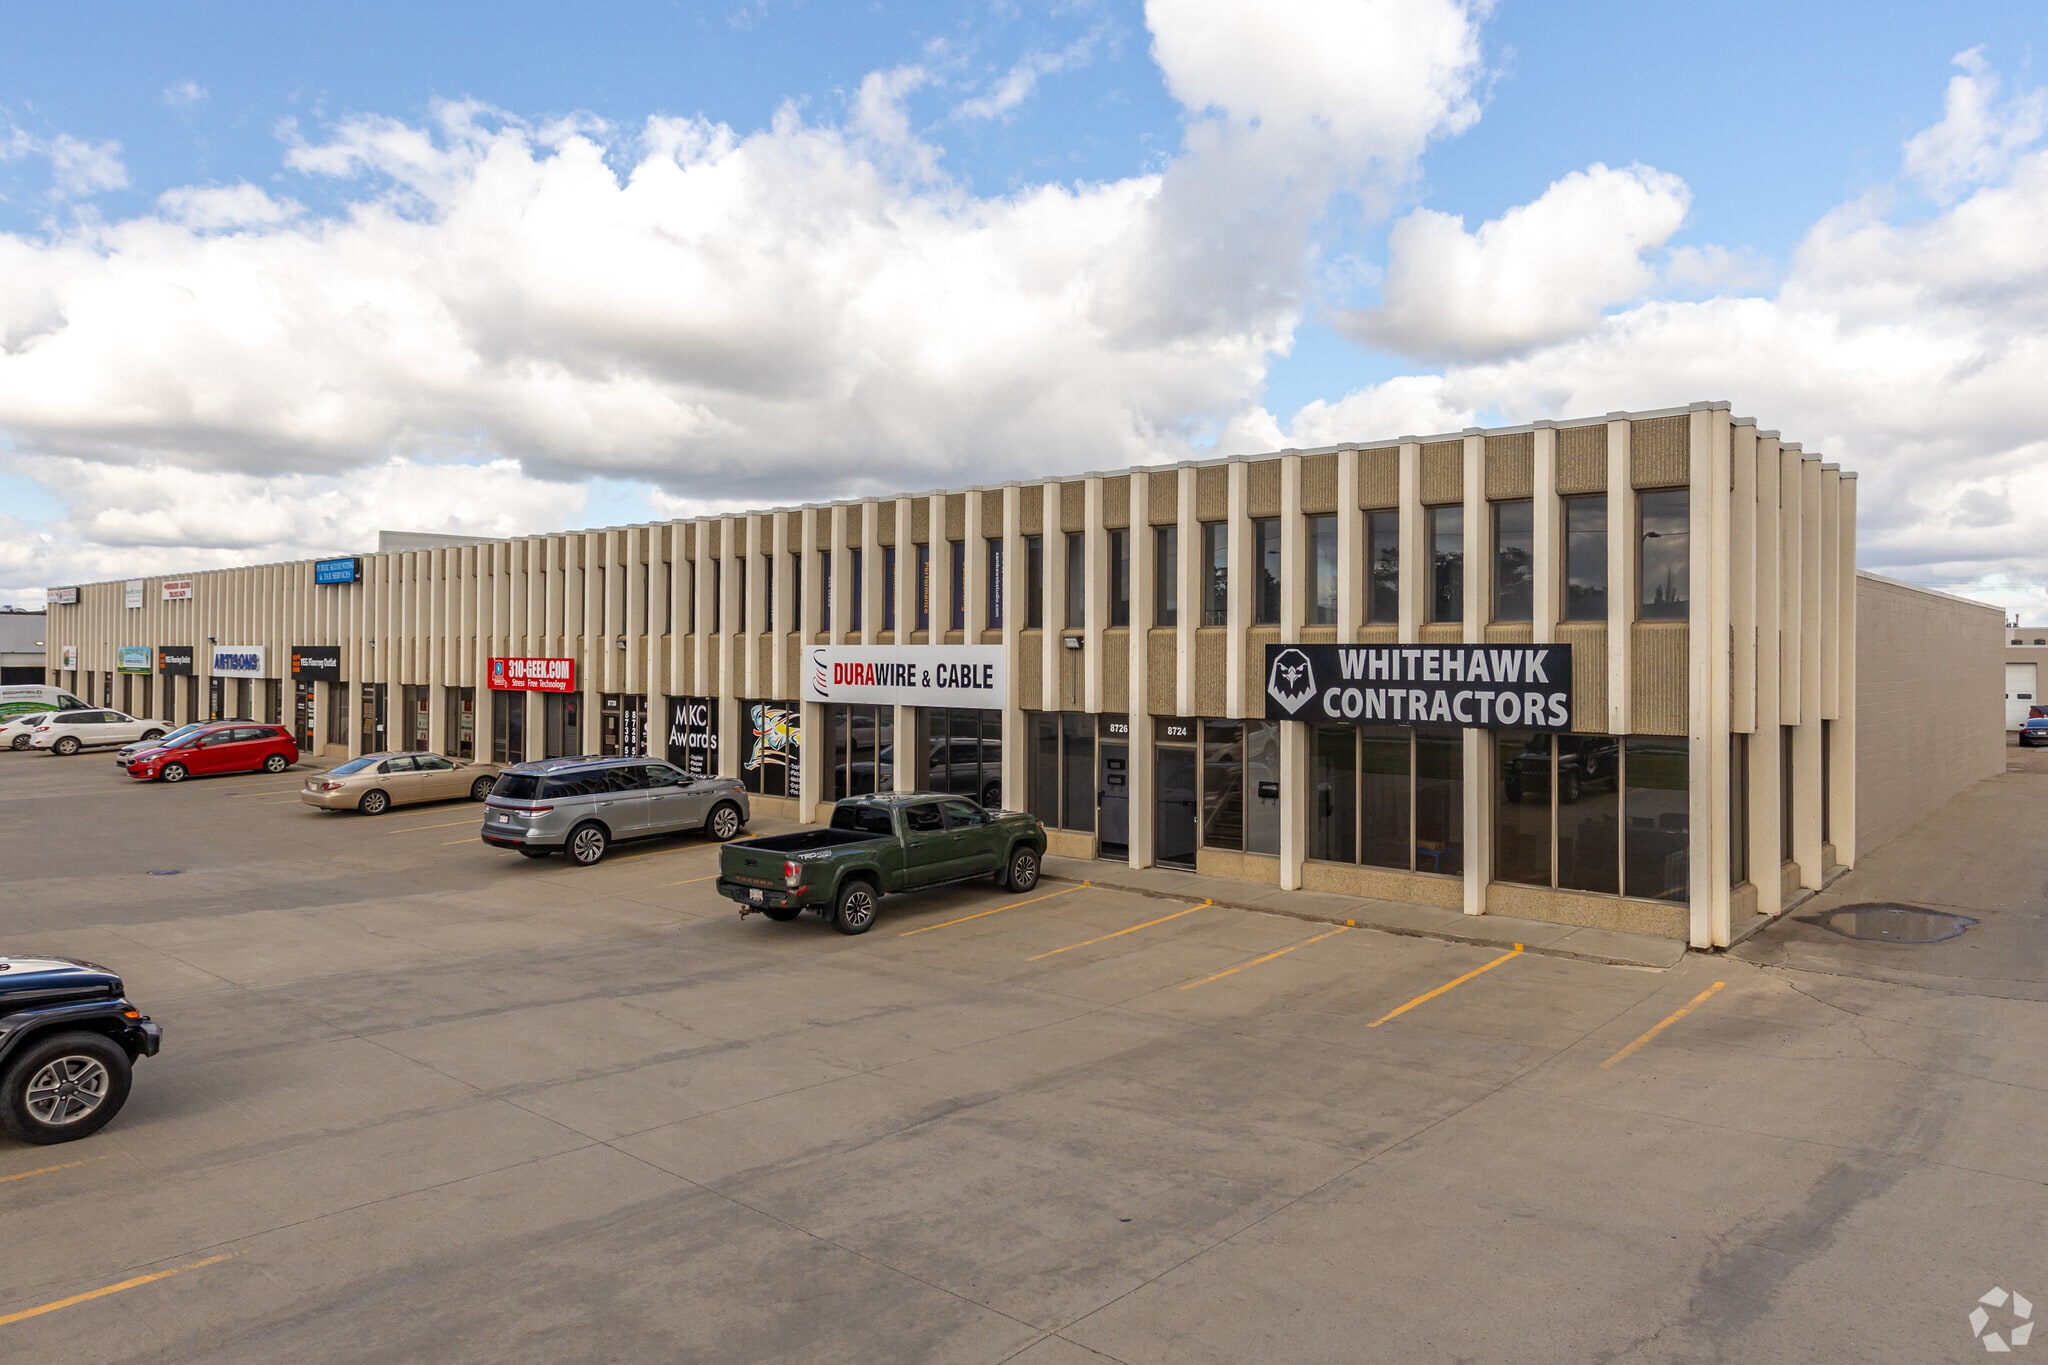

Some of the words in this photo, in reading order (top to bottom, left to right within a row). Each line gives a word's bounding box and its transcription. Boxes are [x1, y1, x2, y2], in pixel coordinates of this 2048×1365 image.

[508, 660, 569, 679] 310-GEEK.COM
[833, 662, 917, 687] DURAWIRE
[921, 669, 931, 688] &
[936, 663, 994, 689] CABLE
[1338, 649, 1549, 683] WHITEHAWK
[540, 680, 566, 690] Technology
[676, 704, 706, 726] MKC
[1323, 687, 1568, 726] CONTRACTORS
[669, 725, 717, 749] Awards
[1110, 723, 1128, 733] 8726
[1167, 726, 1188, 737] 8724
